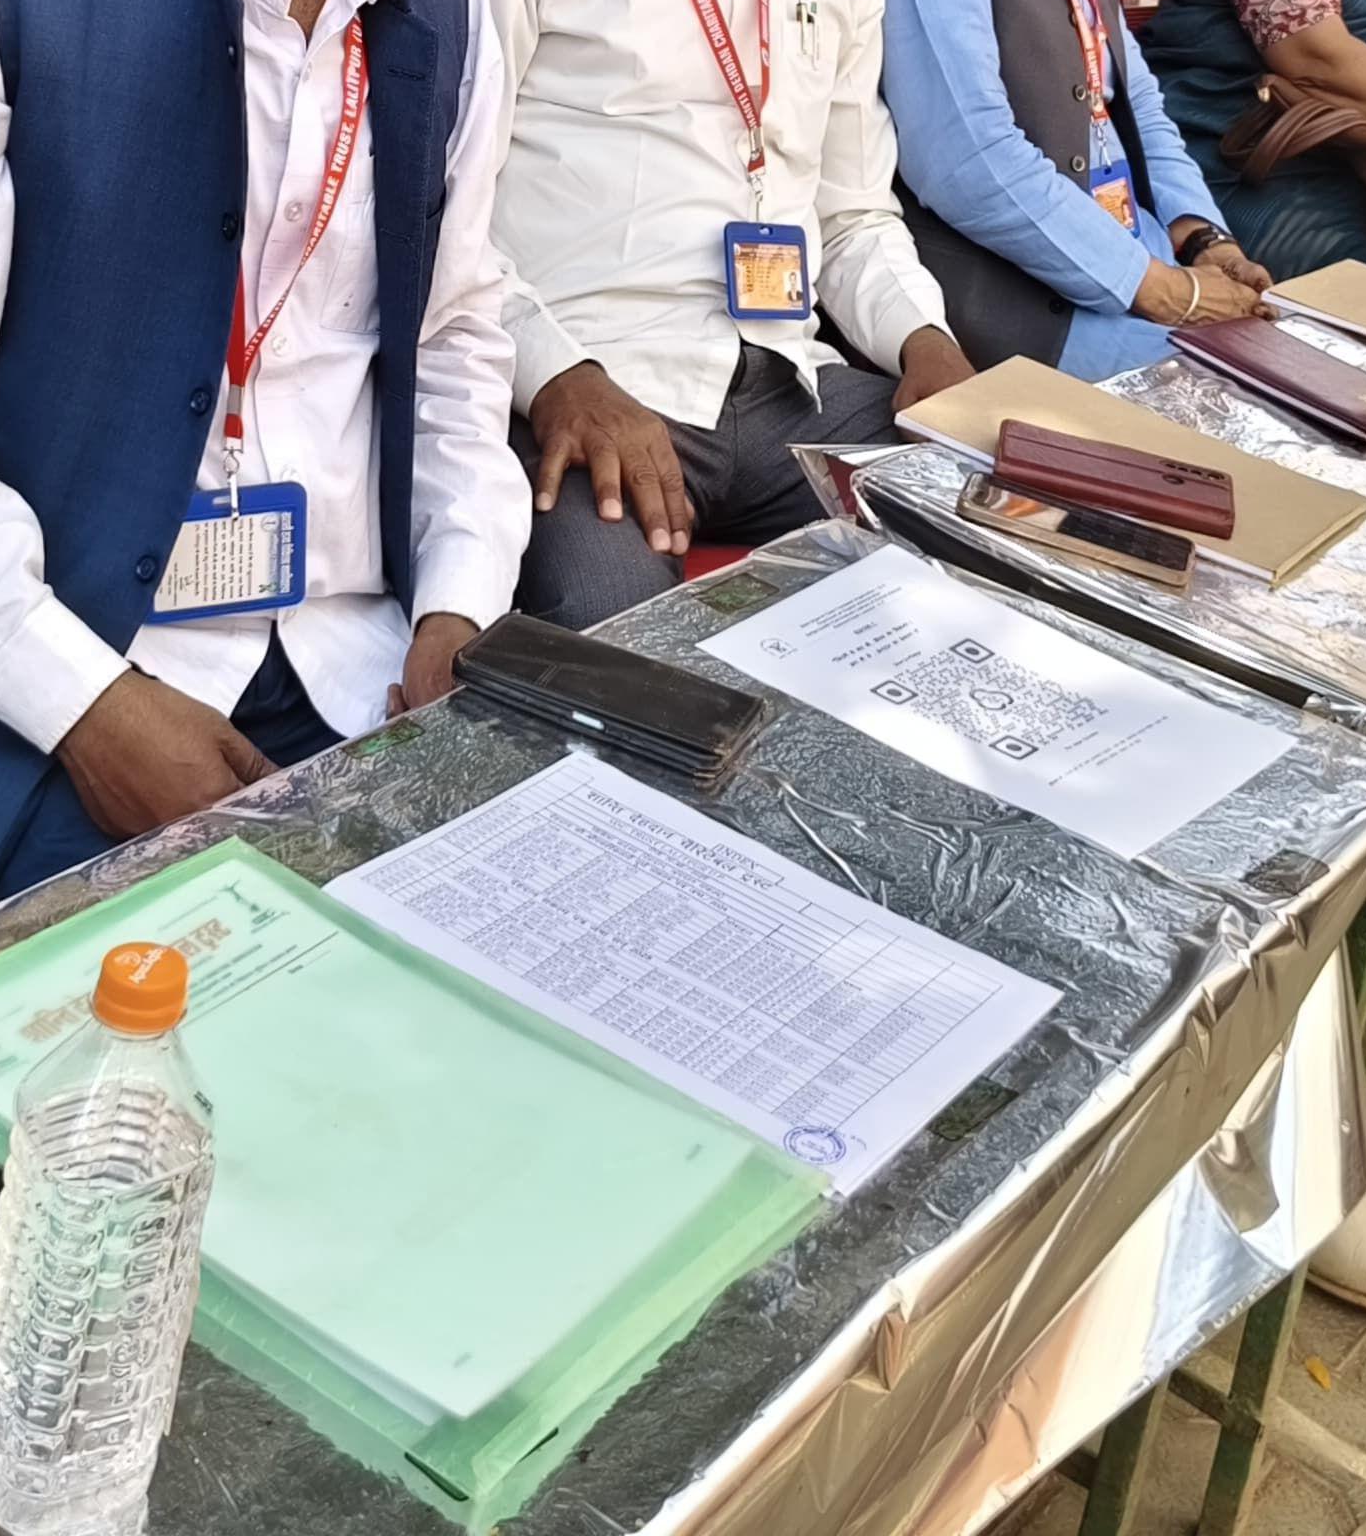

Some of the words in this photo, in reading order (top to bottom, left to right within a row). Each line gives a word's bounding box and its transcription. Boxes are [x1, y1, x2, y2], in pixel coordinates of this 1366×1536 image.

[329, 44, 377, 118] LALITPUR
[716, 45, 747, 92] DEHDAN
[714, 842, 758, 871] INDEX
